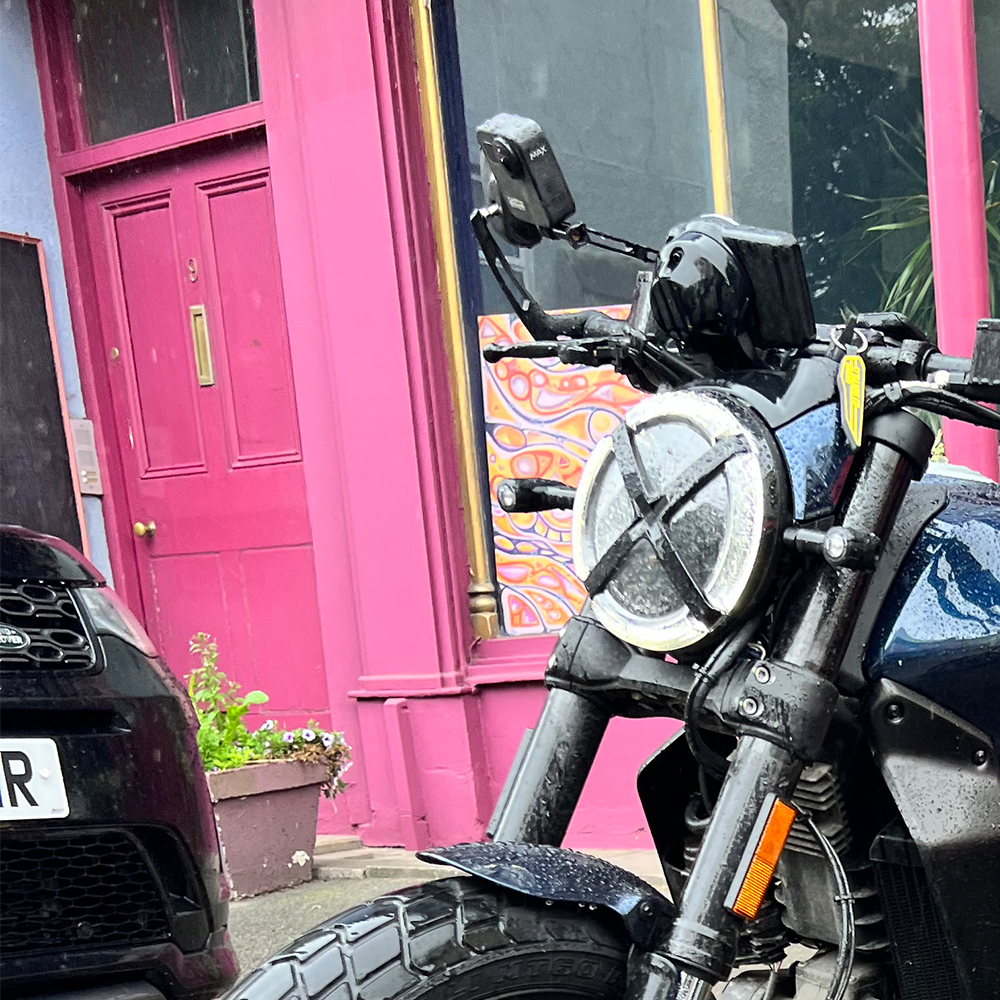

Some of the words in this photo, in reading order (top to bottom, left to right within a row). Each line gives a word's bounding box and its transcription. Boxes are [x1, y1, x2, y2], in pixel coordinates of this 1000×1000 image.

[529, 145, 548, 161] MAX
[187, 257, 199, 284] 9
[0, 635, 24, 645] OVER
[0, 750, 40, 808] R
[494, 957, 601, 984] MT60
